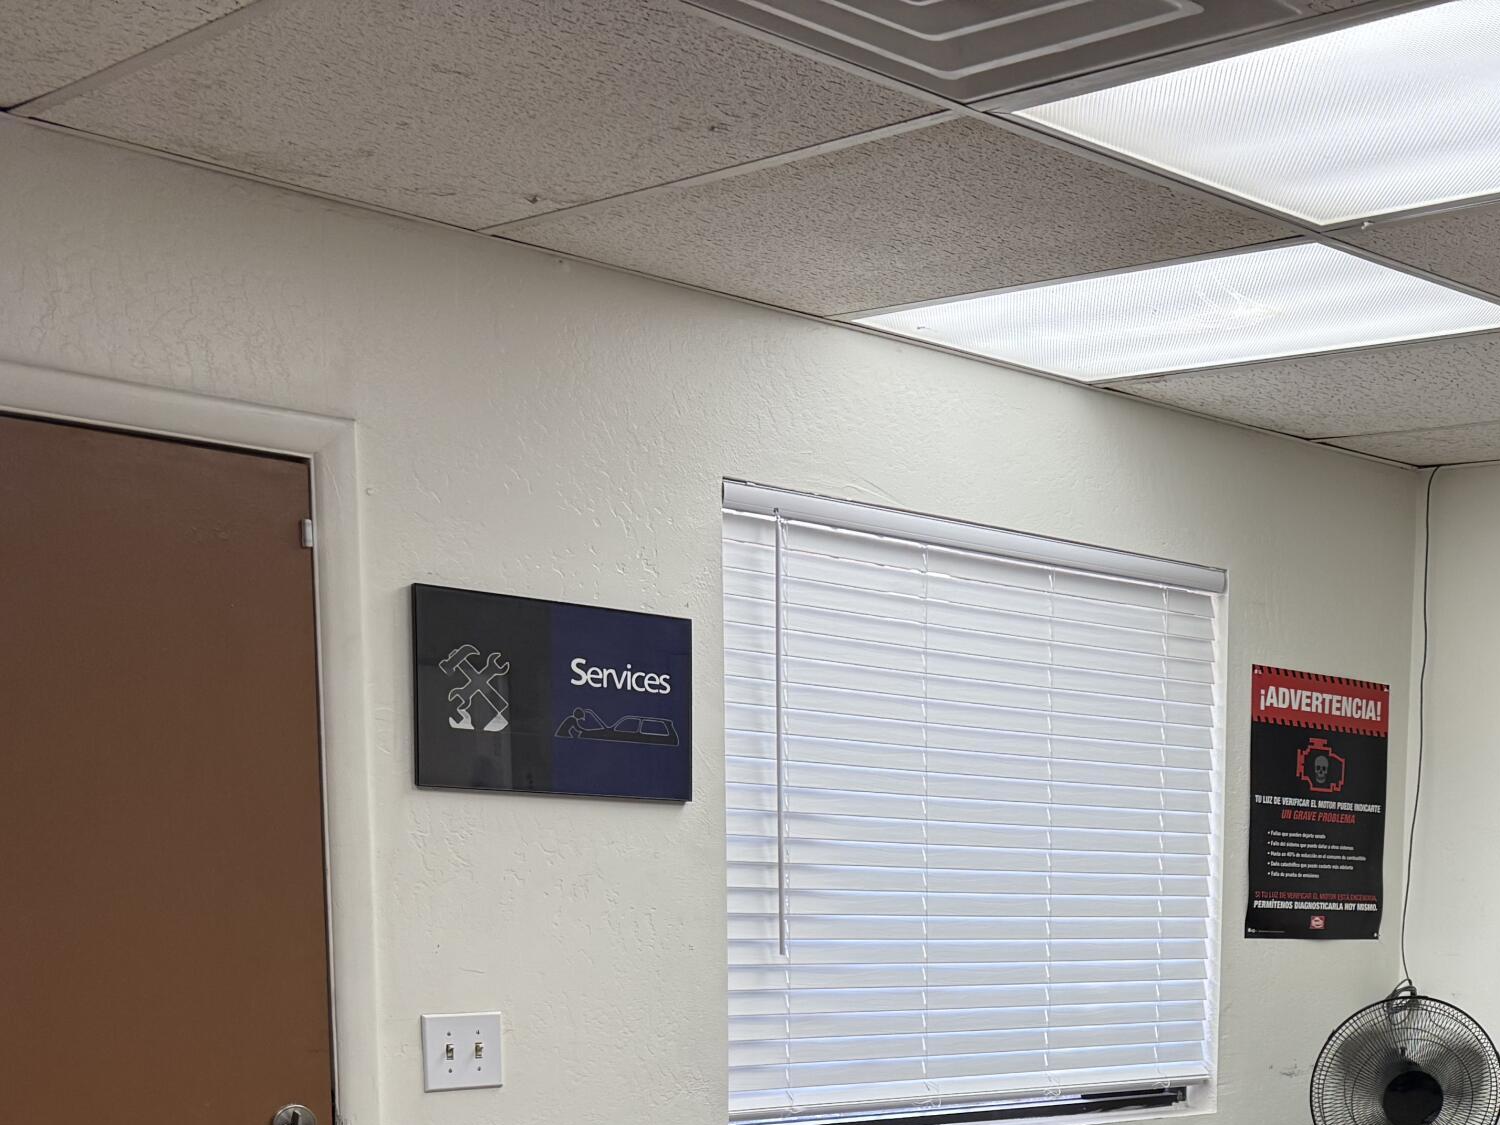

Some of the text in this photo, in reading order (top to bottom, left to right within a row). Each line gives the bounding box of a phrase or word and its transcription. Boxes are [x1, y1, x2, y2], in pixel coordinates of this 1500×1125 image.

[571, 657, 671, 694] Services
[1260, 686, 1381, 721] ¡ADVERTENCIA!
[1255, 794, 1381, 813] TU LUZ DE VERIFICAR EL MOTOR PUEDE INDICARTE
[1281, 809, 1356, 824] UN GRAVE PROBLEMA
[1254, 898, 1293, 909] PERMÍTENOS
[1294, 901, 1343, 910] DIAGNOSTICARLA
[1344, 902, 1356, 911] HOY
